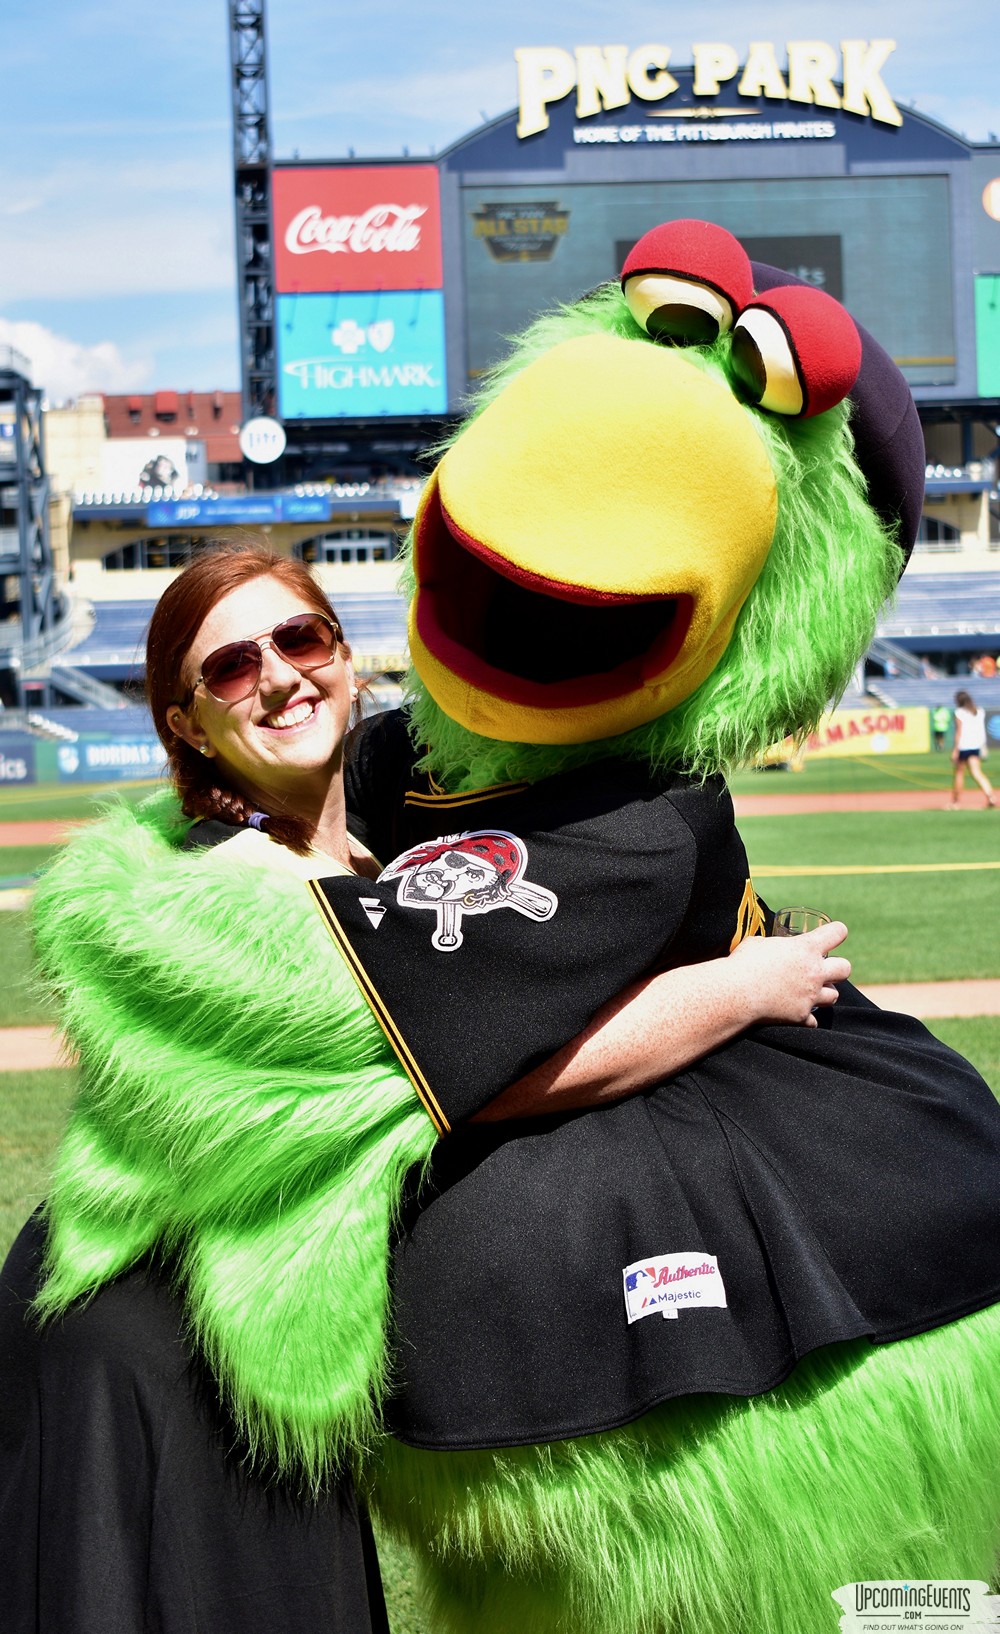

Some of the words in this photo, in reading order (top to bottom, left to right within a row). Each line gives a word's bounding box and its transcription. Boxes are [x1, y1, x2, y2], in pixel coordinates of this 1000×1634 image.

[514, 44, 680, 139] PNC
[693, 39, 903, 127] PARK
[573, 126, 620, 144] HOME
[620, 126, 643, 142] OF
[644, 124, 676, 142] THE
[676, 122, 773, 140] PITTSBURGH
[773, 121, 837, 138] PIRATES
[653, 1262, 716, 1289] Authentic
[657, 1290, 702, 1303] Majestic
